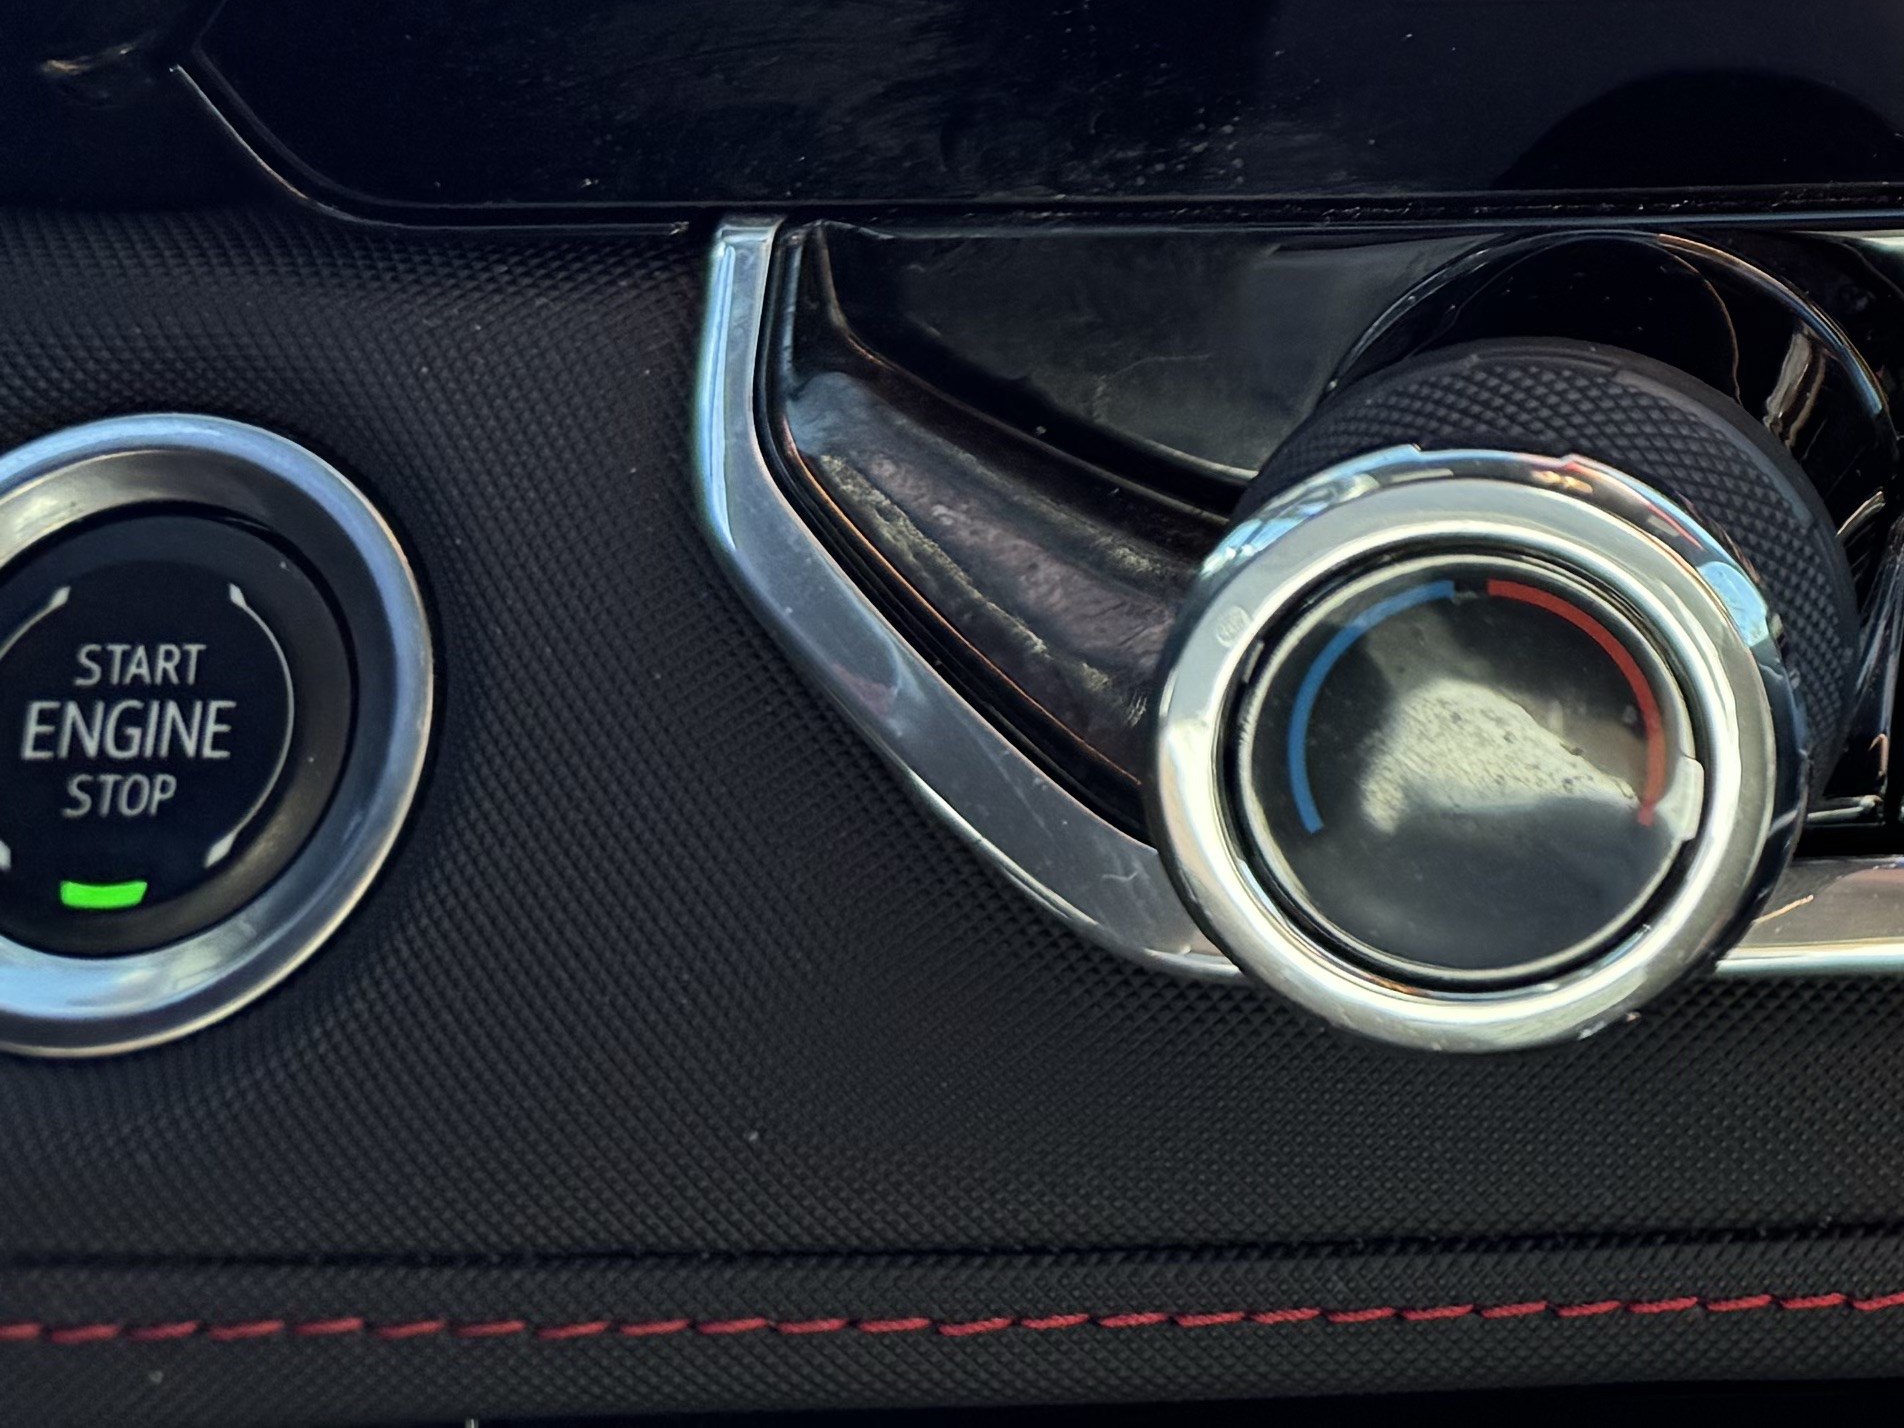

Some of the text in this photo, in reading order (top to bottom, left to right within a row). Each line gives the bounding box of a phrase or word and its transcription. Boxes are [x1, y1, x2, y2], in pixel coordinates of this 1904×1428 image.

[74, 643, 207, 686] START
[21, 700, 237, 760] ENGINE
[62, 773, 178, 818] STOP
